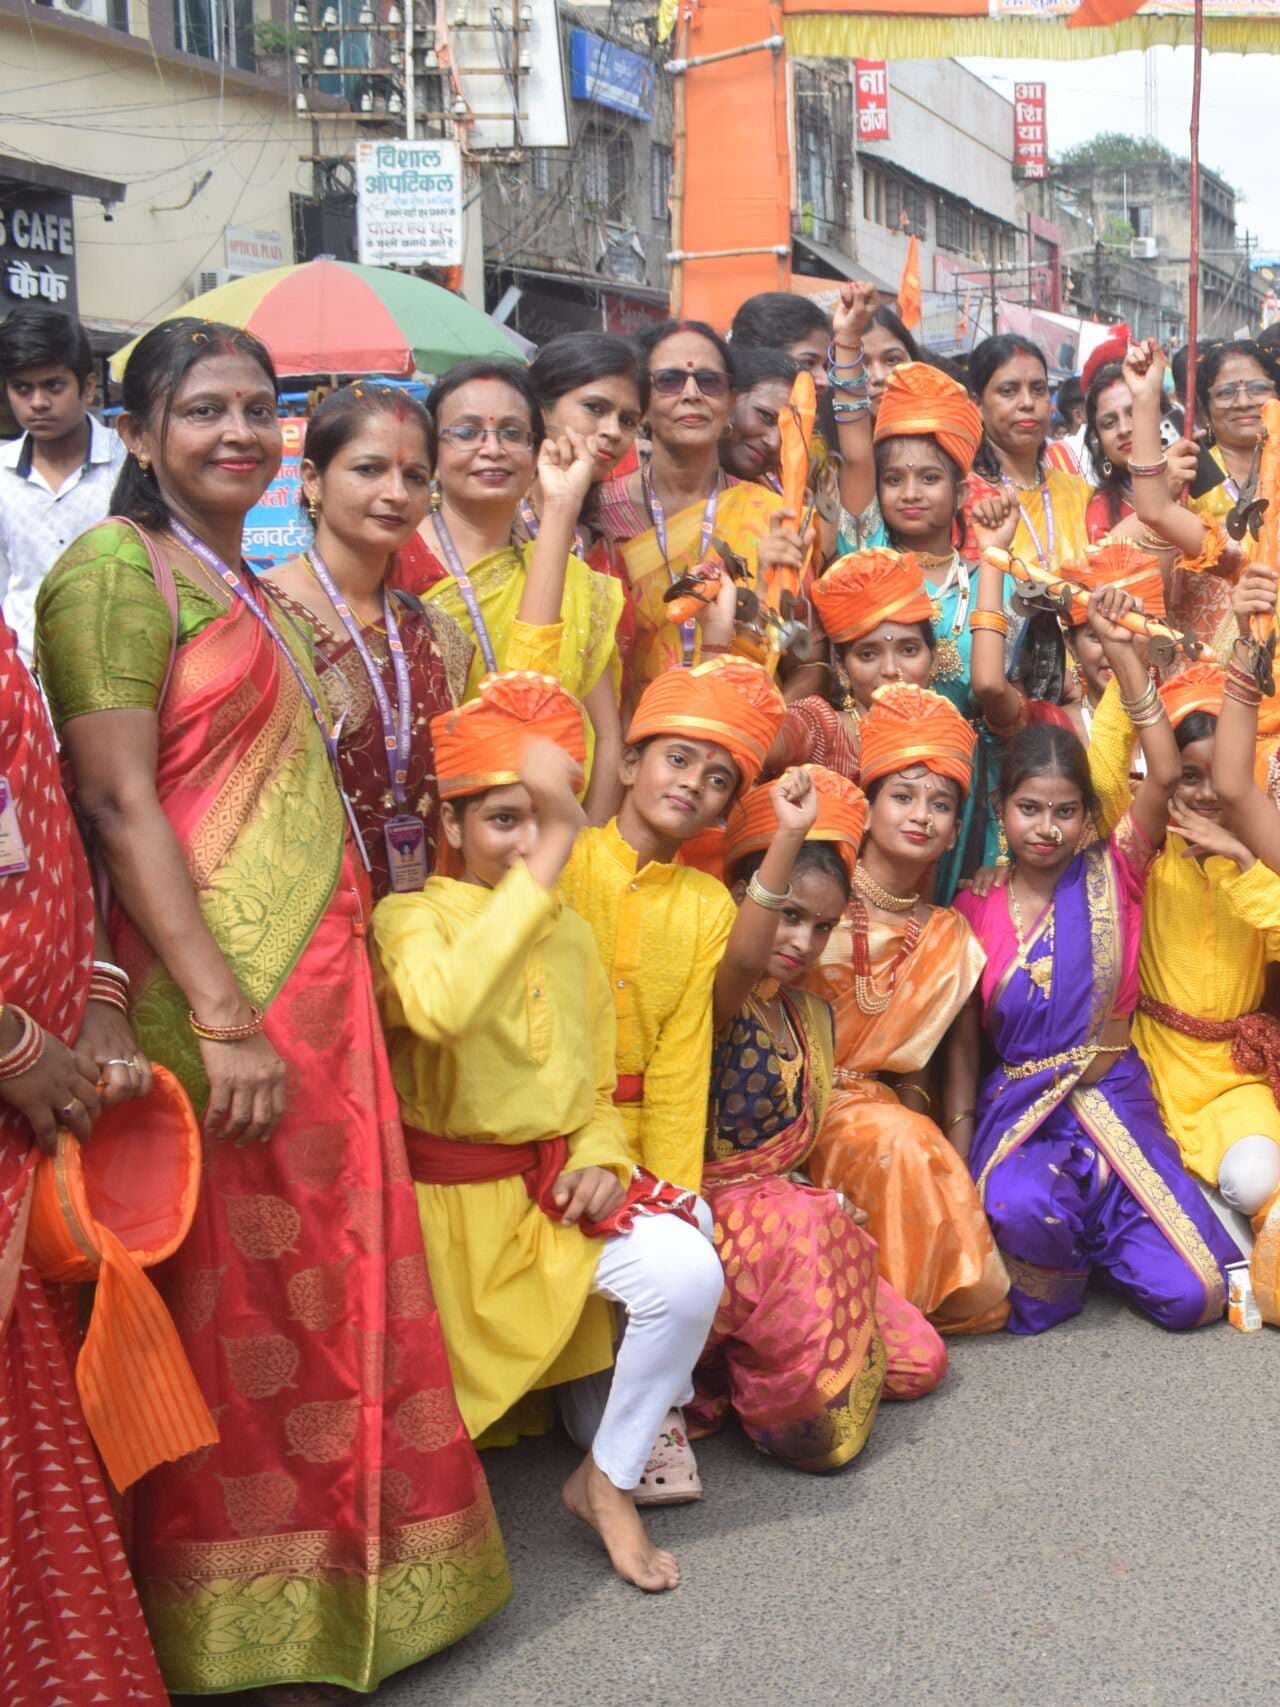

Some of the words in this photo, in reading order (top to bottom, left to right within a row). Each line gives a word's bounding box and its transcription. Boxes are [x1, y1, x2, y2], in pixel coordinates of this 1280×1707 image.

[376, 144, 441, 169] विशाल
[13, 208, 73, 256] CAFE
[8, 260, 69, 303] कैफे
